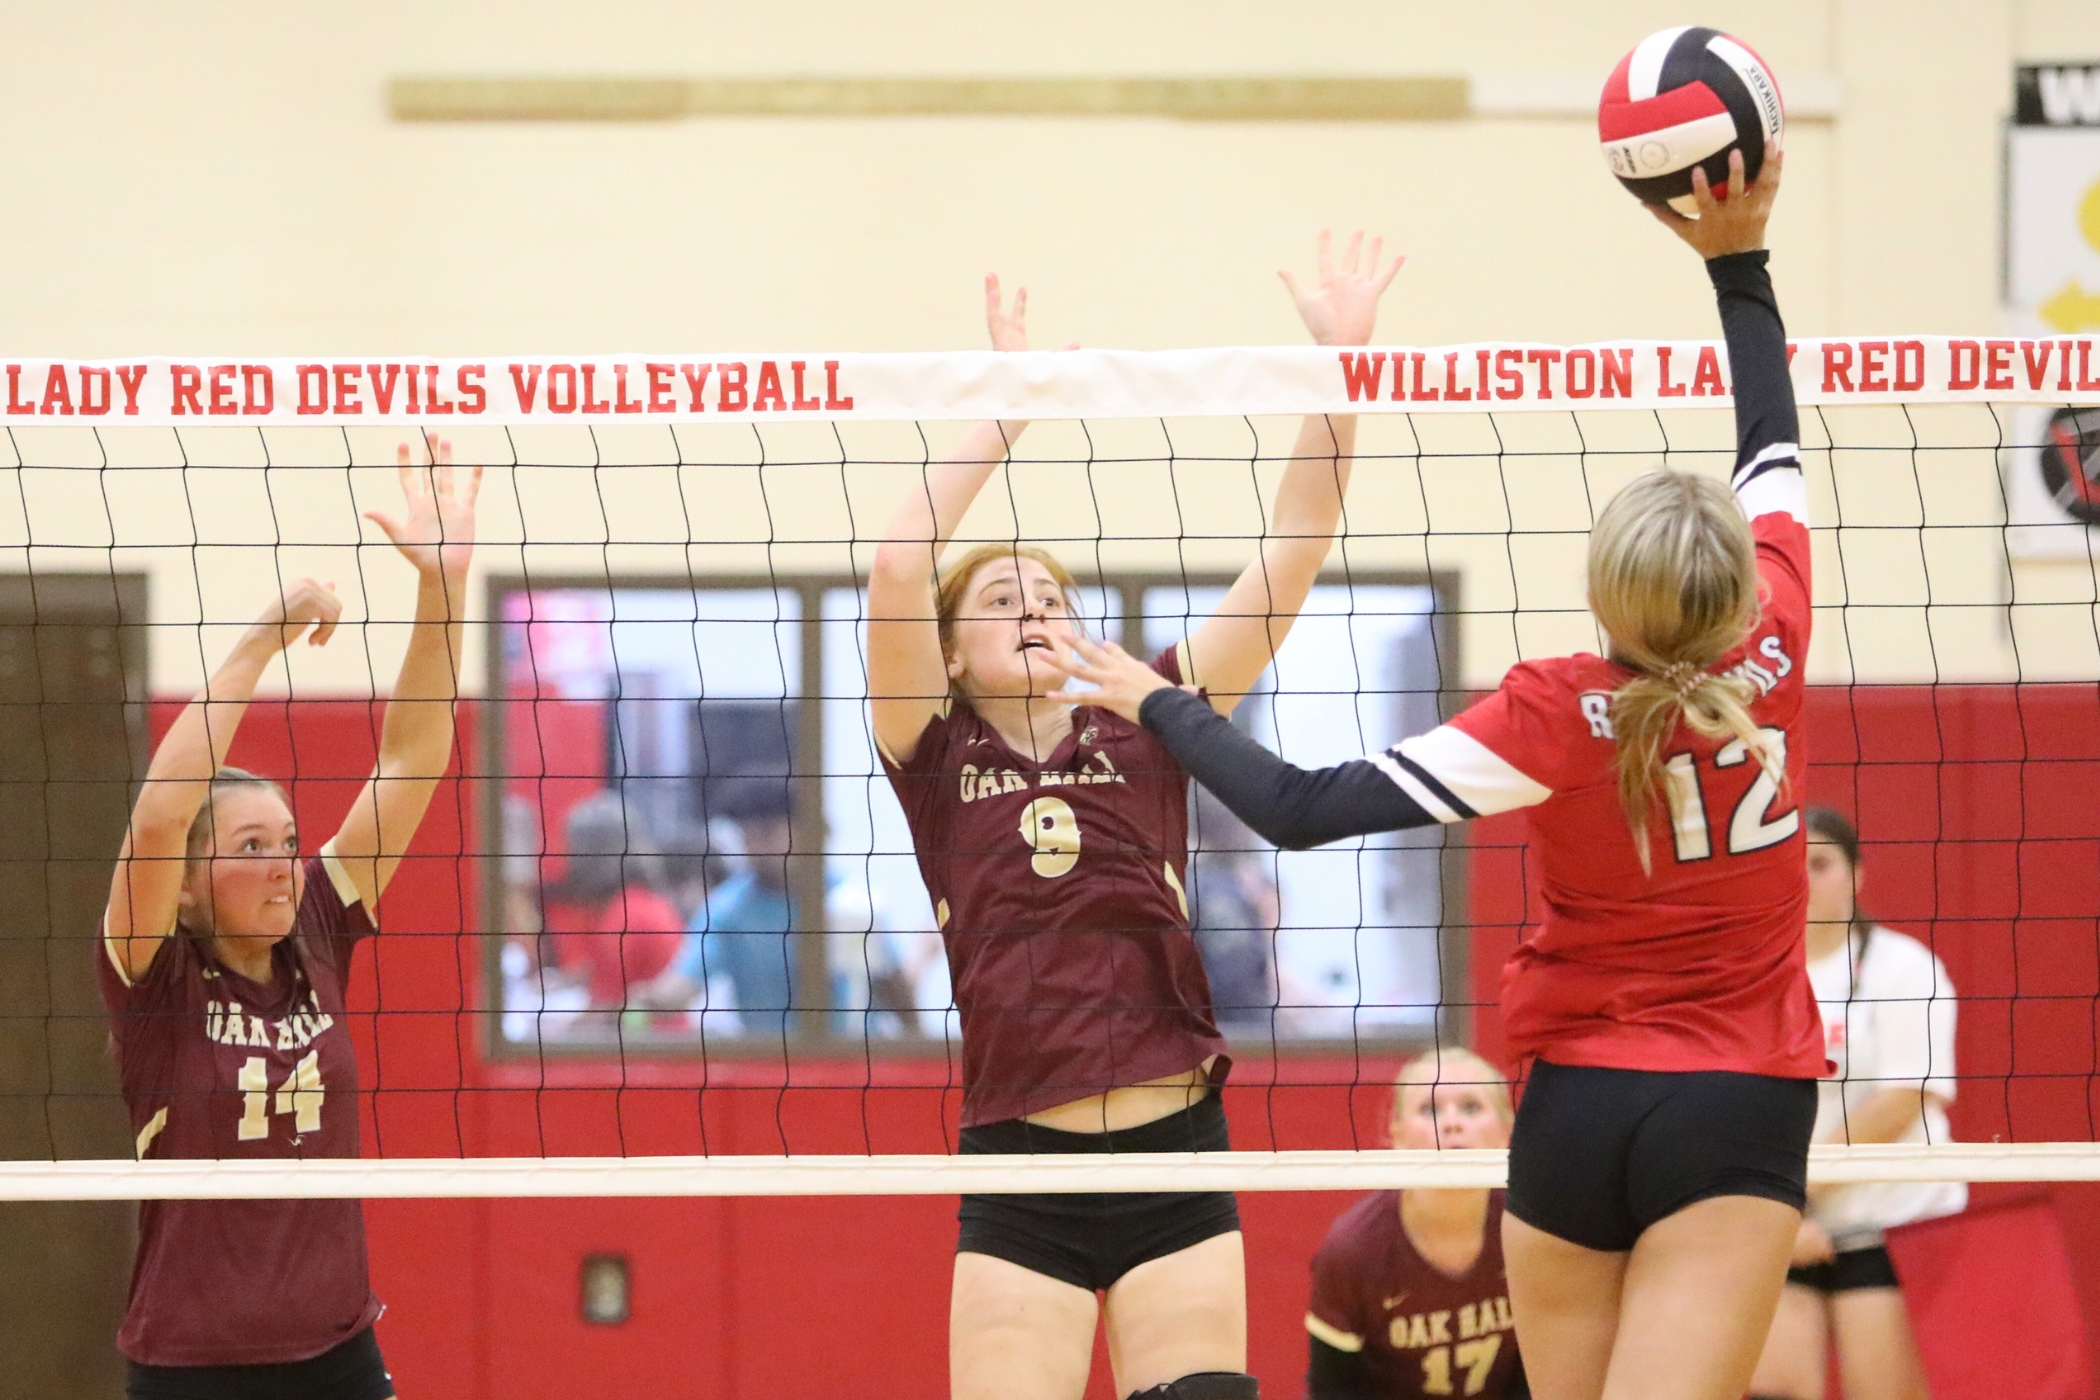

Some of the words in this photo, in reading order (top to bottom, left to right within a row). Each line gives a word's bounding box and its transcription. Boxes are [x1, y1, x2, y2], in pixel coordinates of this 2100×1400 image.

[5, 363, 148, 416] LADY
[170, 363, 274, 416] RED
[296, 363, 487, 415] DEVILS
[508, 360, 854, 414] VOLLEYBALL
[1338, 348, 1634, 402] WILLISTON
[1656, 344, 1798, 398] LA
[1821, 340, 1925, 393] RED
[1665, 725, 1799, 863] 12
[1018, 796, 1082, 878] 9
[238, 1050, 325, 1140] 14
[1389, 1311, 1452, 1349] OAK
[1457, 1296, 1515, 1341] HAL
[1421, 1334, 1504, 1396] 17
